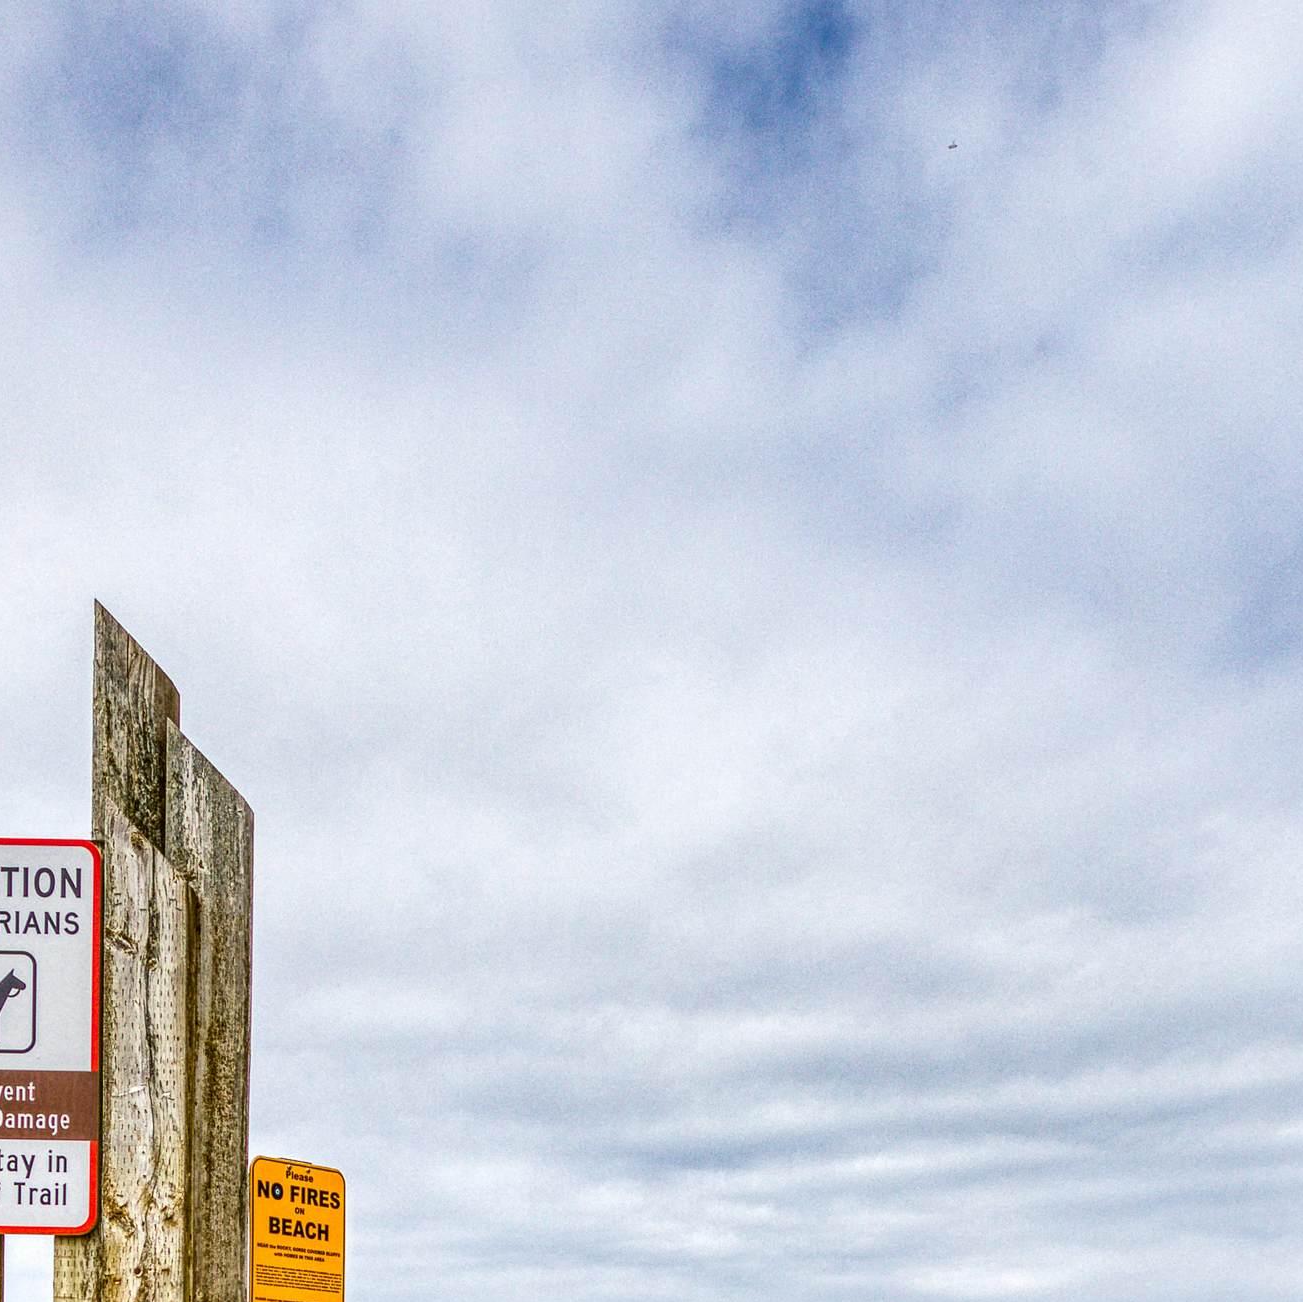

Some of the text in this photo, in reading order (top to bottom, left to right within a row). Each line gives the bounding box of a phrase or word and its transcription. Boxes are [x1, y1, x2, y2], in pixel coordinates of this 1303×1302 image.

[48, 1150, 67, 1173] in
[286, 1170, 314, 1183] Please
[14, 1182, 67, 1205] Trail
[257, 1180, 340, 1209] NO FIRES
[295, 1207, 305, 1215] ON
[269, 1216, 329, 1241] BEACH
